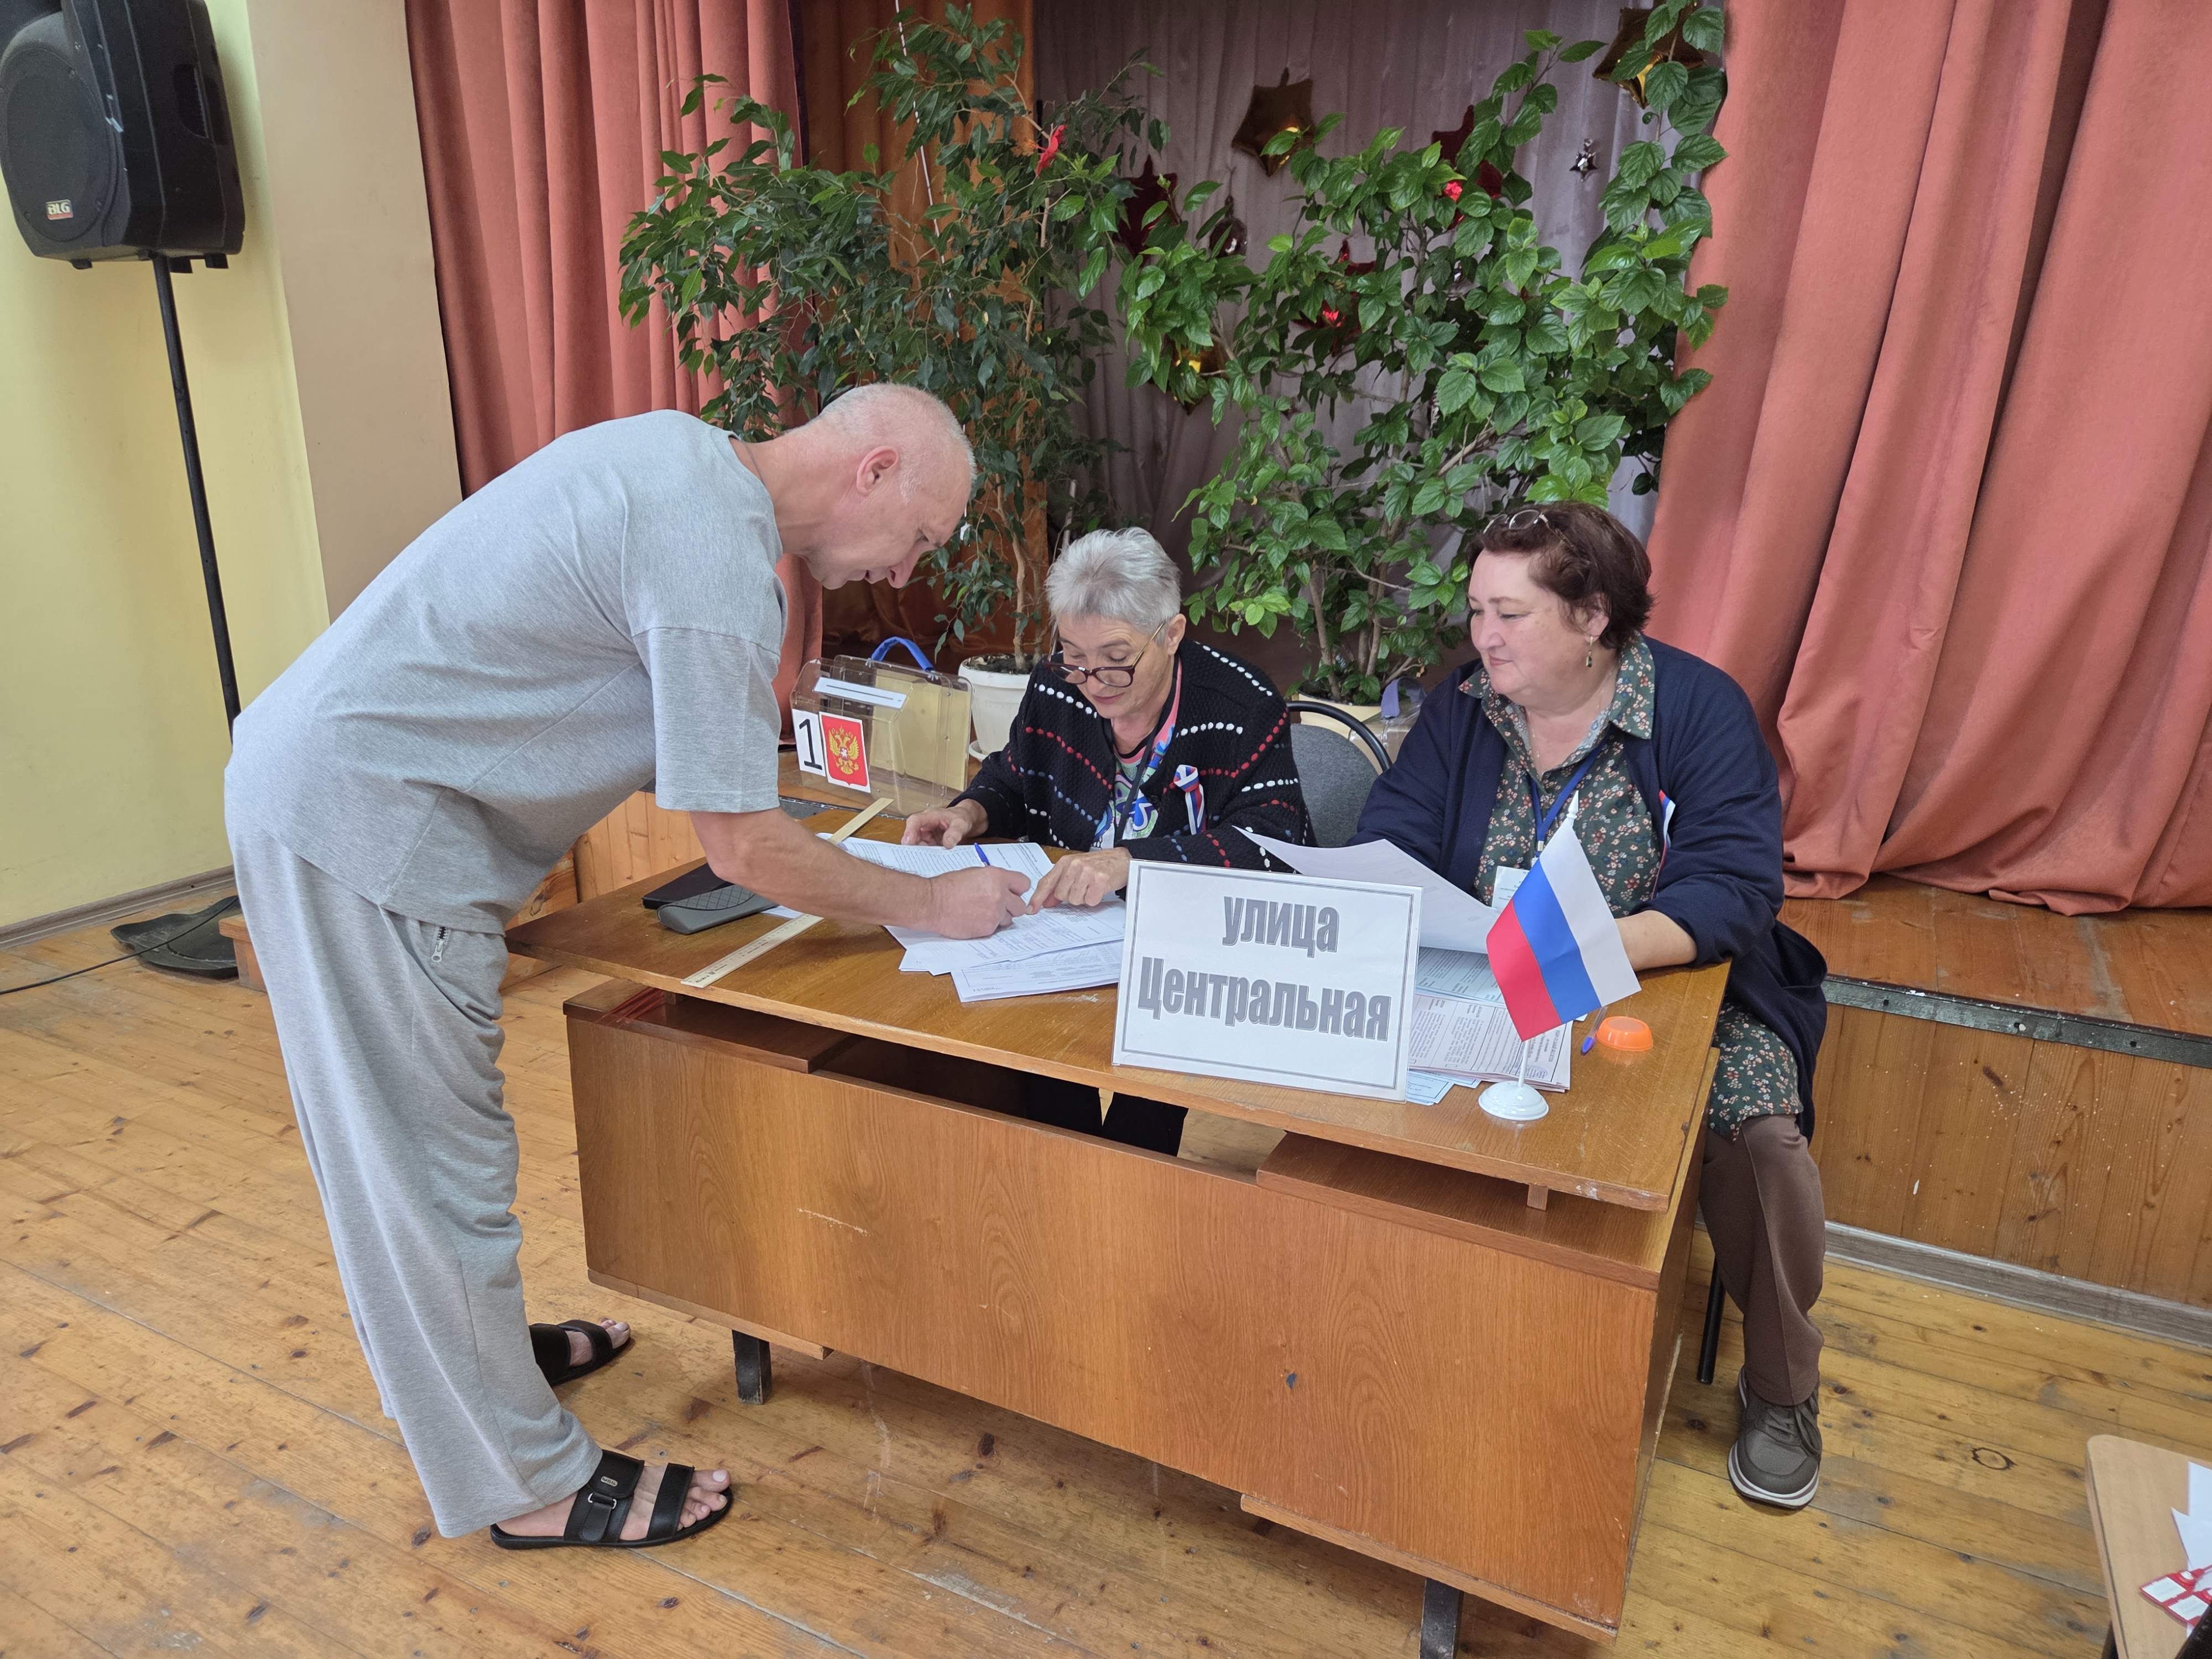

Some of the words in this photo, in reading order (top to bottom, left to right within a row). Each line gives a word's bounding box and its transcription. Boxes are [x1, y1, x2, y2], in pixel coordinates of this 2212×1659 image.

[799, 718, 823, 770] 1
[1222, 896, 1339, 958] улица
[1138, 957, 1392, 1041] Центральная
